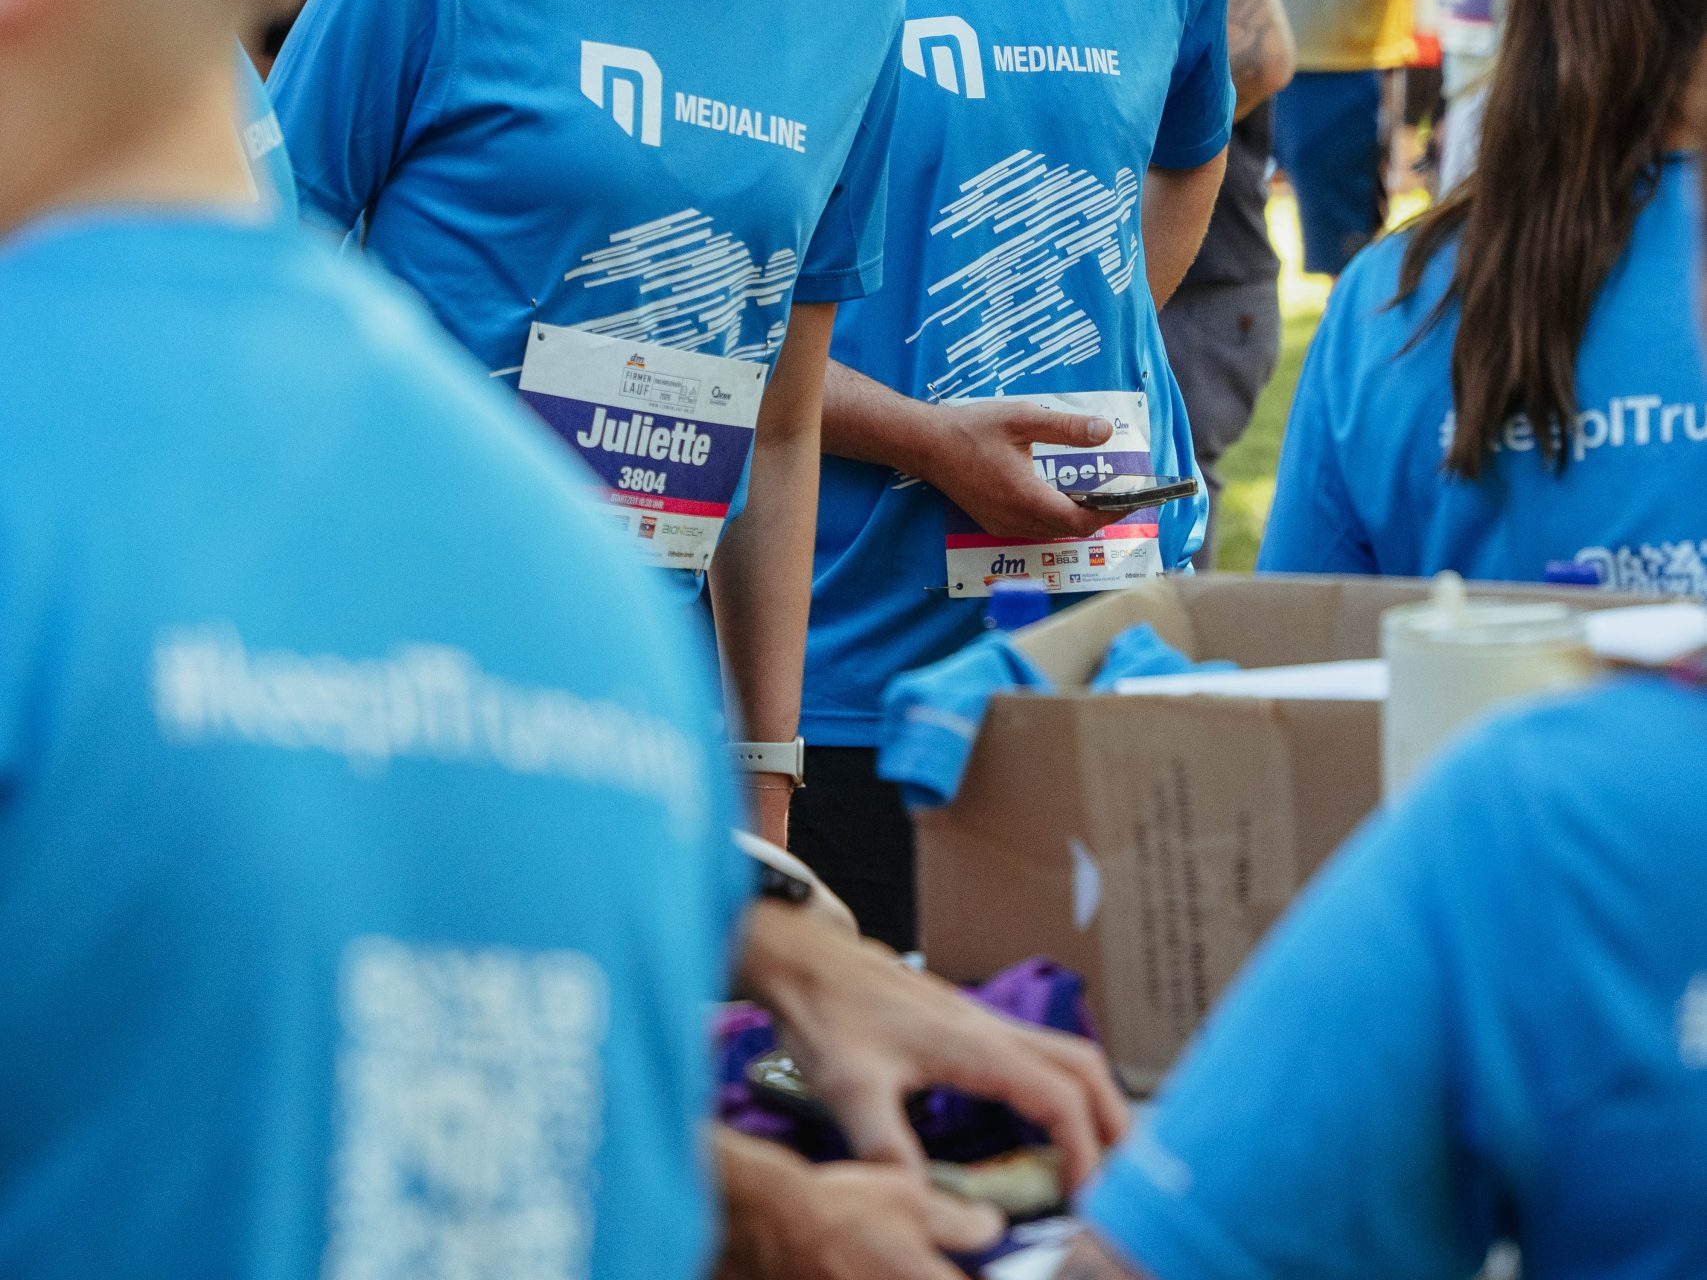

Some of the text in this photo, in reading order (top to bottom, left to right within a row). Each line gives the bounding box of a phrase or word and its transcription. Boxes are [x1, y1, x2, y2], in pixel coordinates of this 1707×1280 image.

[993, 45, 1121, 75] MEDIALINE
[675, 92, 807, 153] MEDIALINE
[630, 353, 645, 363] dm
[623, 381, 650, 396] LAUF
[625, 371, 652, 383] FIRMEN
[576, 407, 712, 466] Juliette
[618, 466, 667, 494] 3804
[990, 554, 1026, 575] dm
